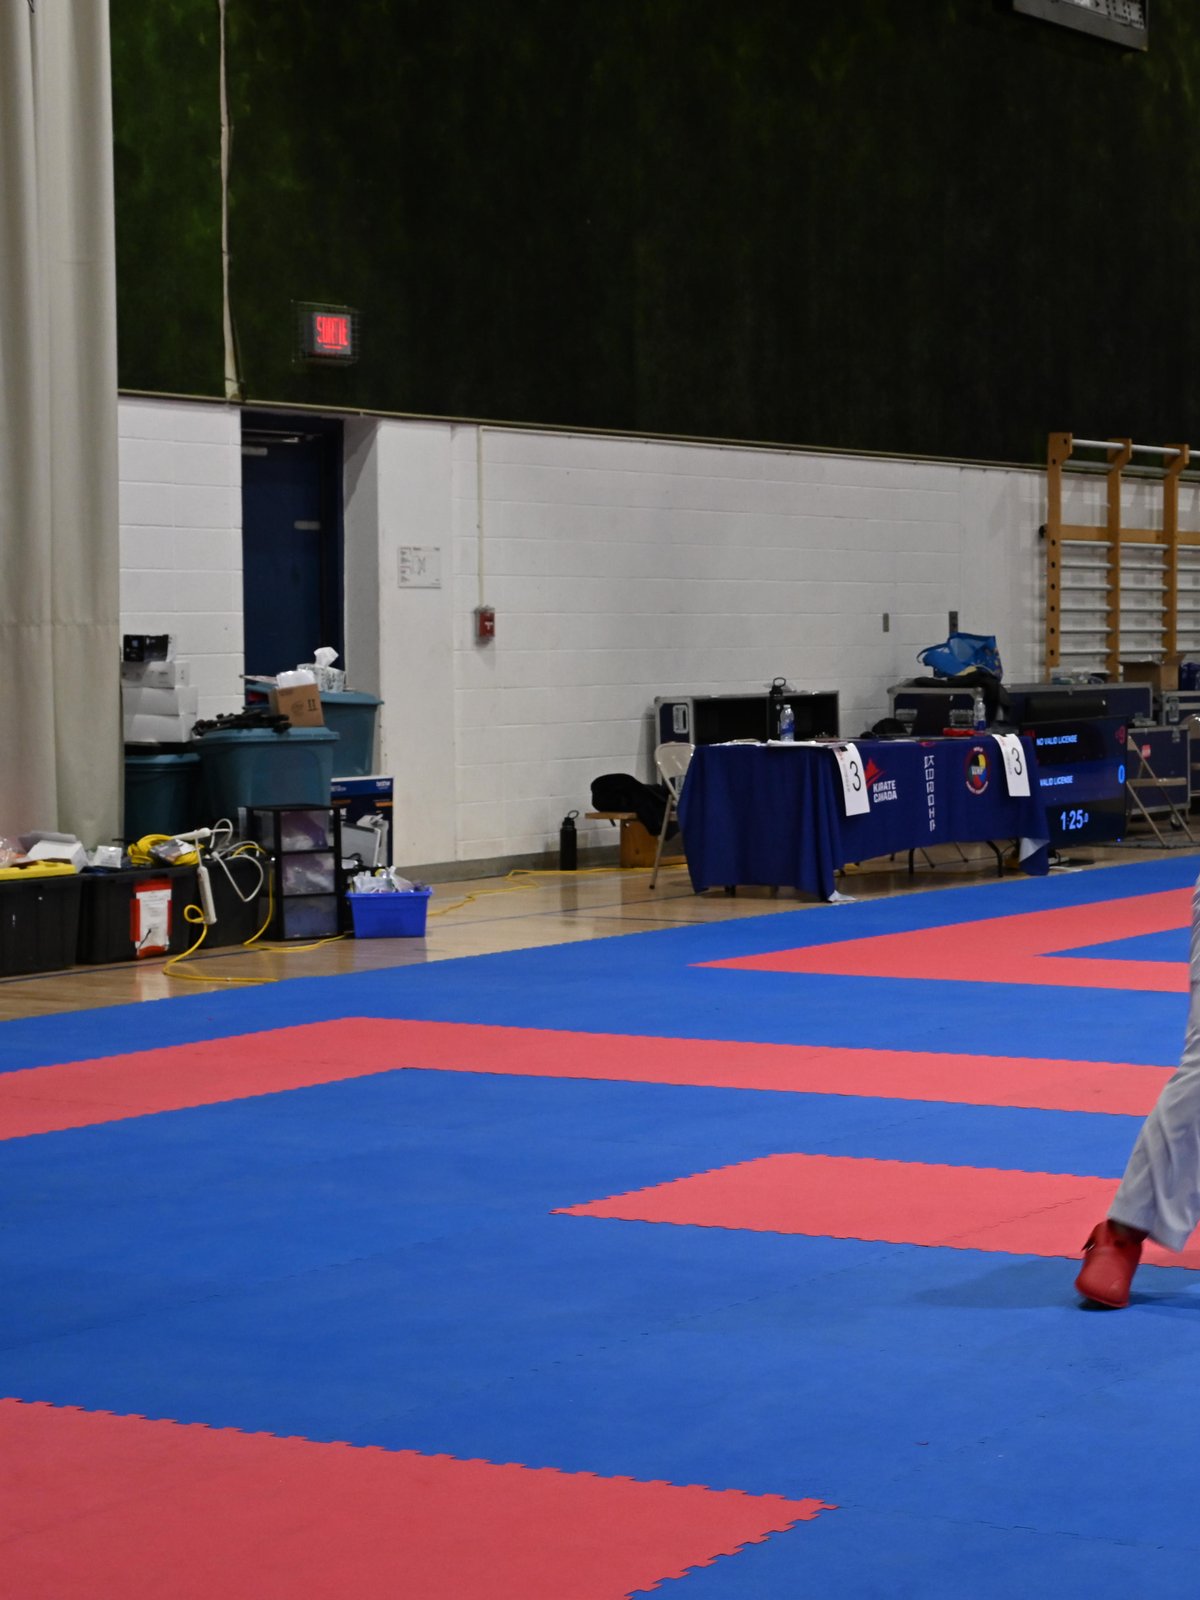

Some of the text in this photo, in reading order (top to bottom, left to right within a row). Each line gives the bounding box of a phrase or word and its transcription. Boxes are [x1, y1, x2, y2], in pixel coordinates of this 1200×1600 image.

[1036, 738, 1044, 746] NO
[1044, 736, 1058, 746] VALID
[1011, 747, 1022, 776] 3
[849, 760, 862, 792] 3
[1118, 764, 1125, 784] 0
[873, 780, 896, 793] KARATE
[873, 790, 898, 803] CANADA
